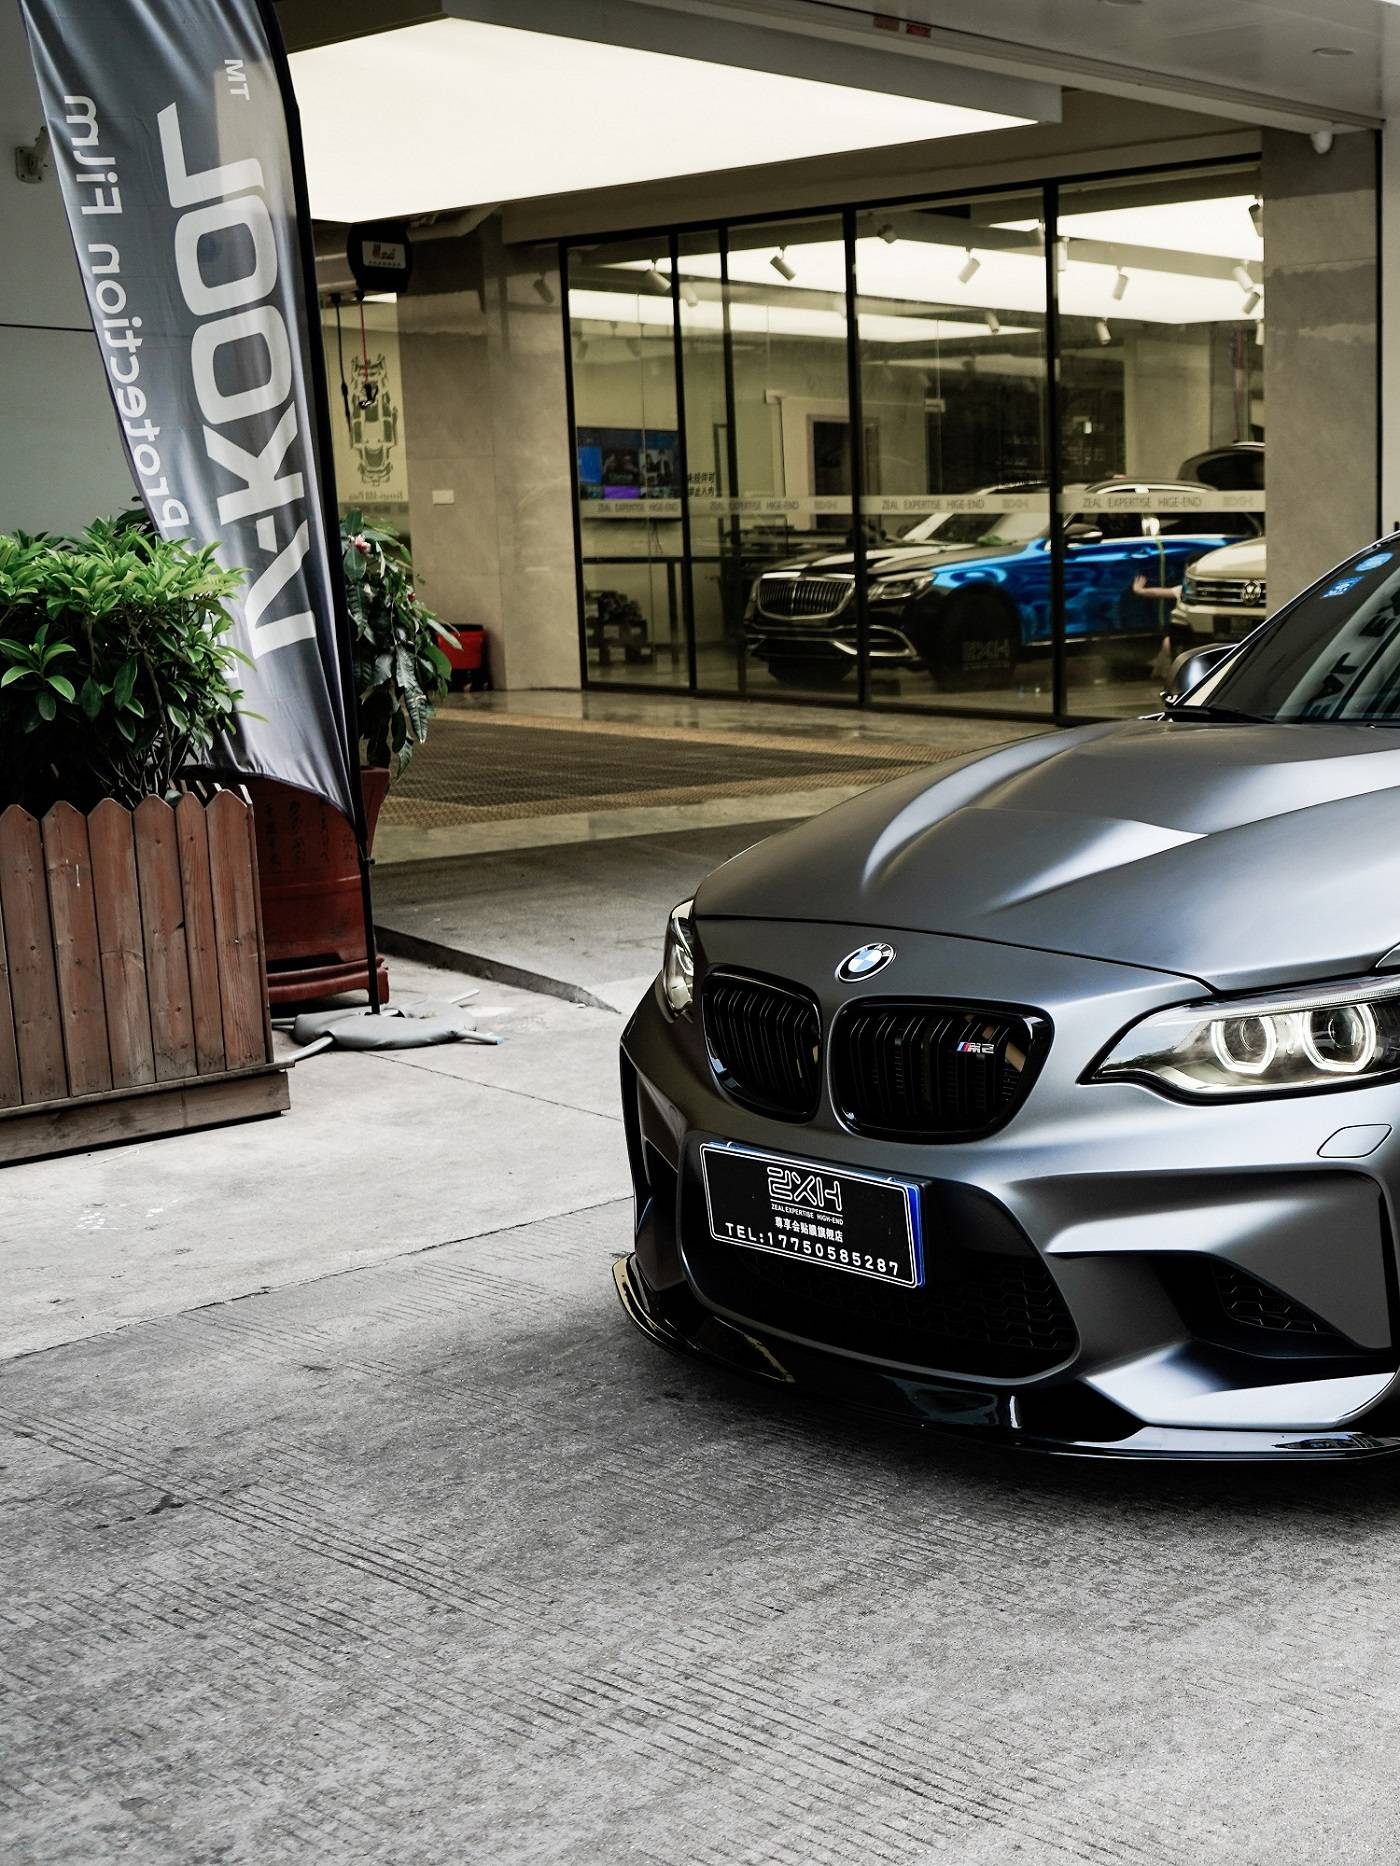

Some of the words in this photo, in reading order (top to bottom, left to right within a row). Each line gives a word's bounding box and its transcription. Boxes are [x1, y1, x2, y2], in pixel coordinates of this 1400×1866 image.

[771, 1203, 785, 1213] ZEAL
[785, 1206, 814, 1219] EXPERTISE
[816, 1213, 844, 1226] HIGH-END
[775, 1217, 843, 1243] 尊享会贴膜旗舰店
[725, 1222, 899, 1276] TEL:17750585287
